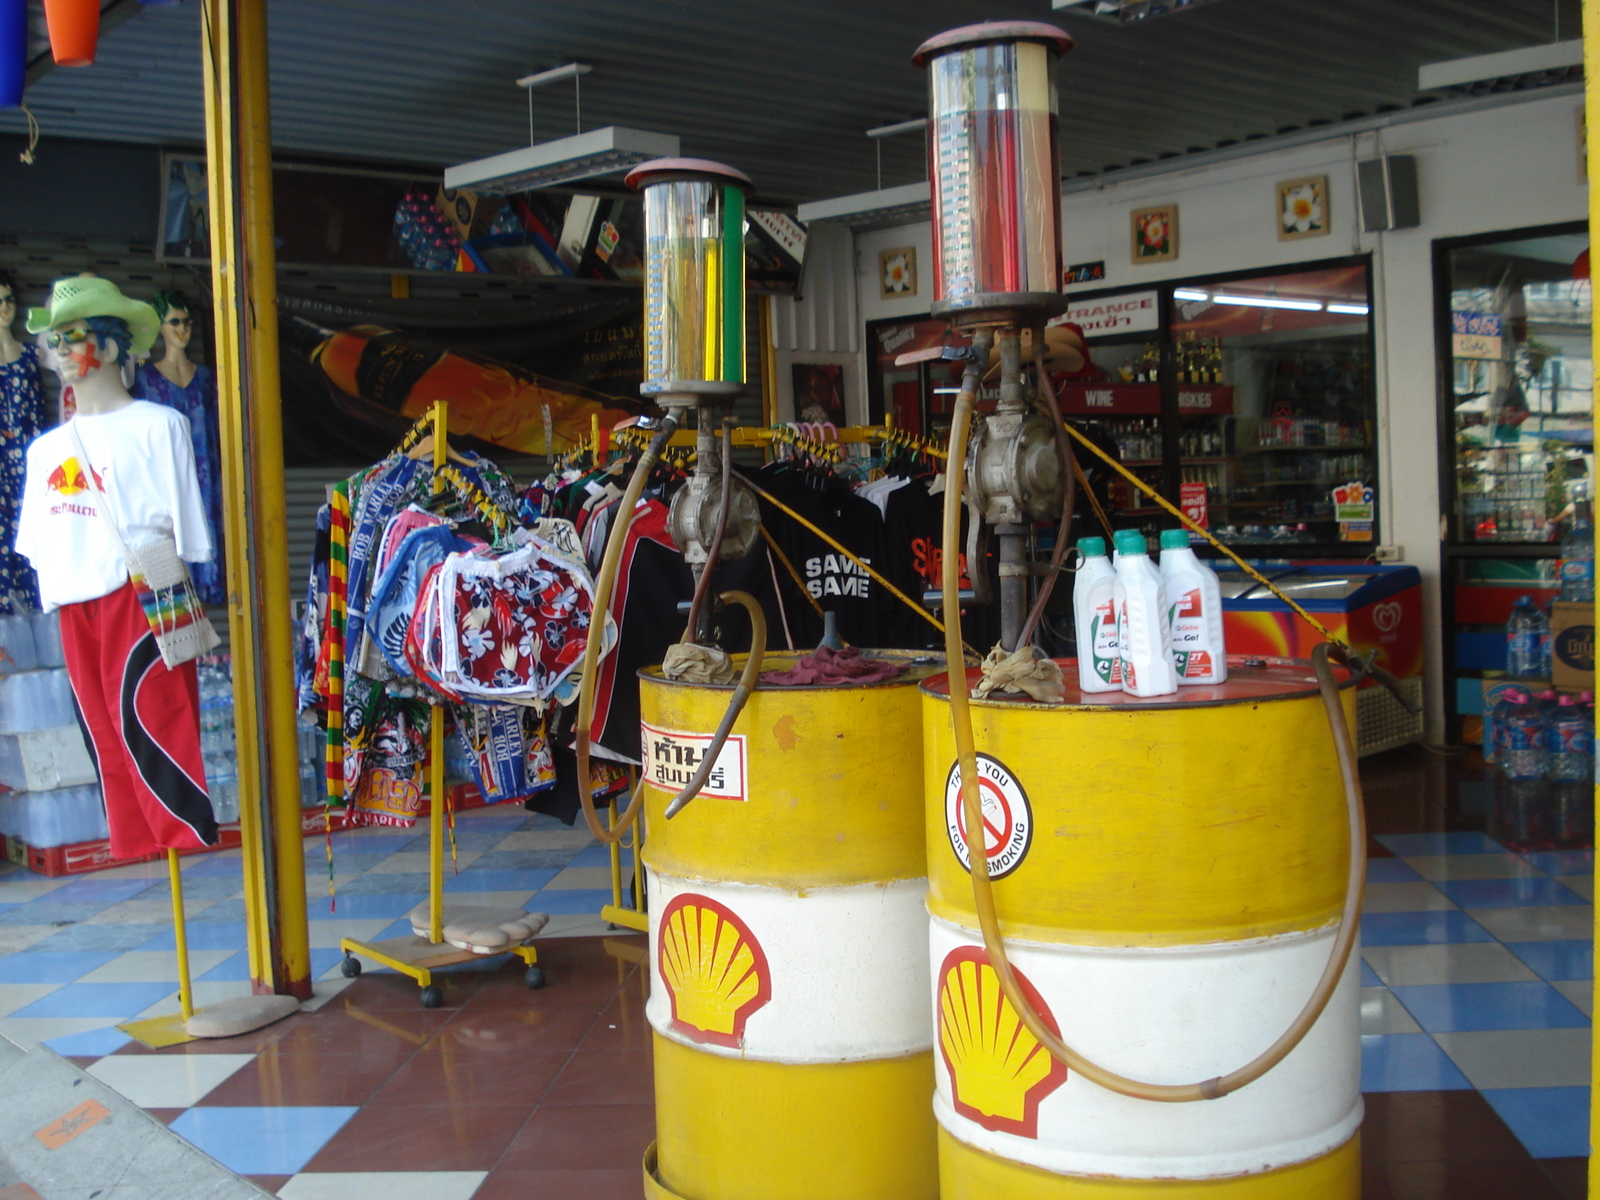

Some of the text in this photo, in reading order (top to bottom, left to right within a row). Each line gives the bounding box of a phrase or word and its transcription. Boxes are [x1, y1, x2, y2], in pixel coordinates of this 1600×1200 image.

[1085, 390, 1114, 407] WINE
[352, 533, 370, 560] BOB
[363, 477, 393, 527] MARLEY
[806, 554, 870, 578] SAME
[807, 576, 869, 599] SAME
[1184, 634, 1199, 642] Go!
[1190, 653, 1203, 661] 2T
[493, 734, 509, 761] BOB
[654, 736, 714, 767] ห้าม
[985, 763, 1009, 788] YOU
[951, 824, 965, 854] FOR
[988, 822, 1026, 874] SMOKING
